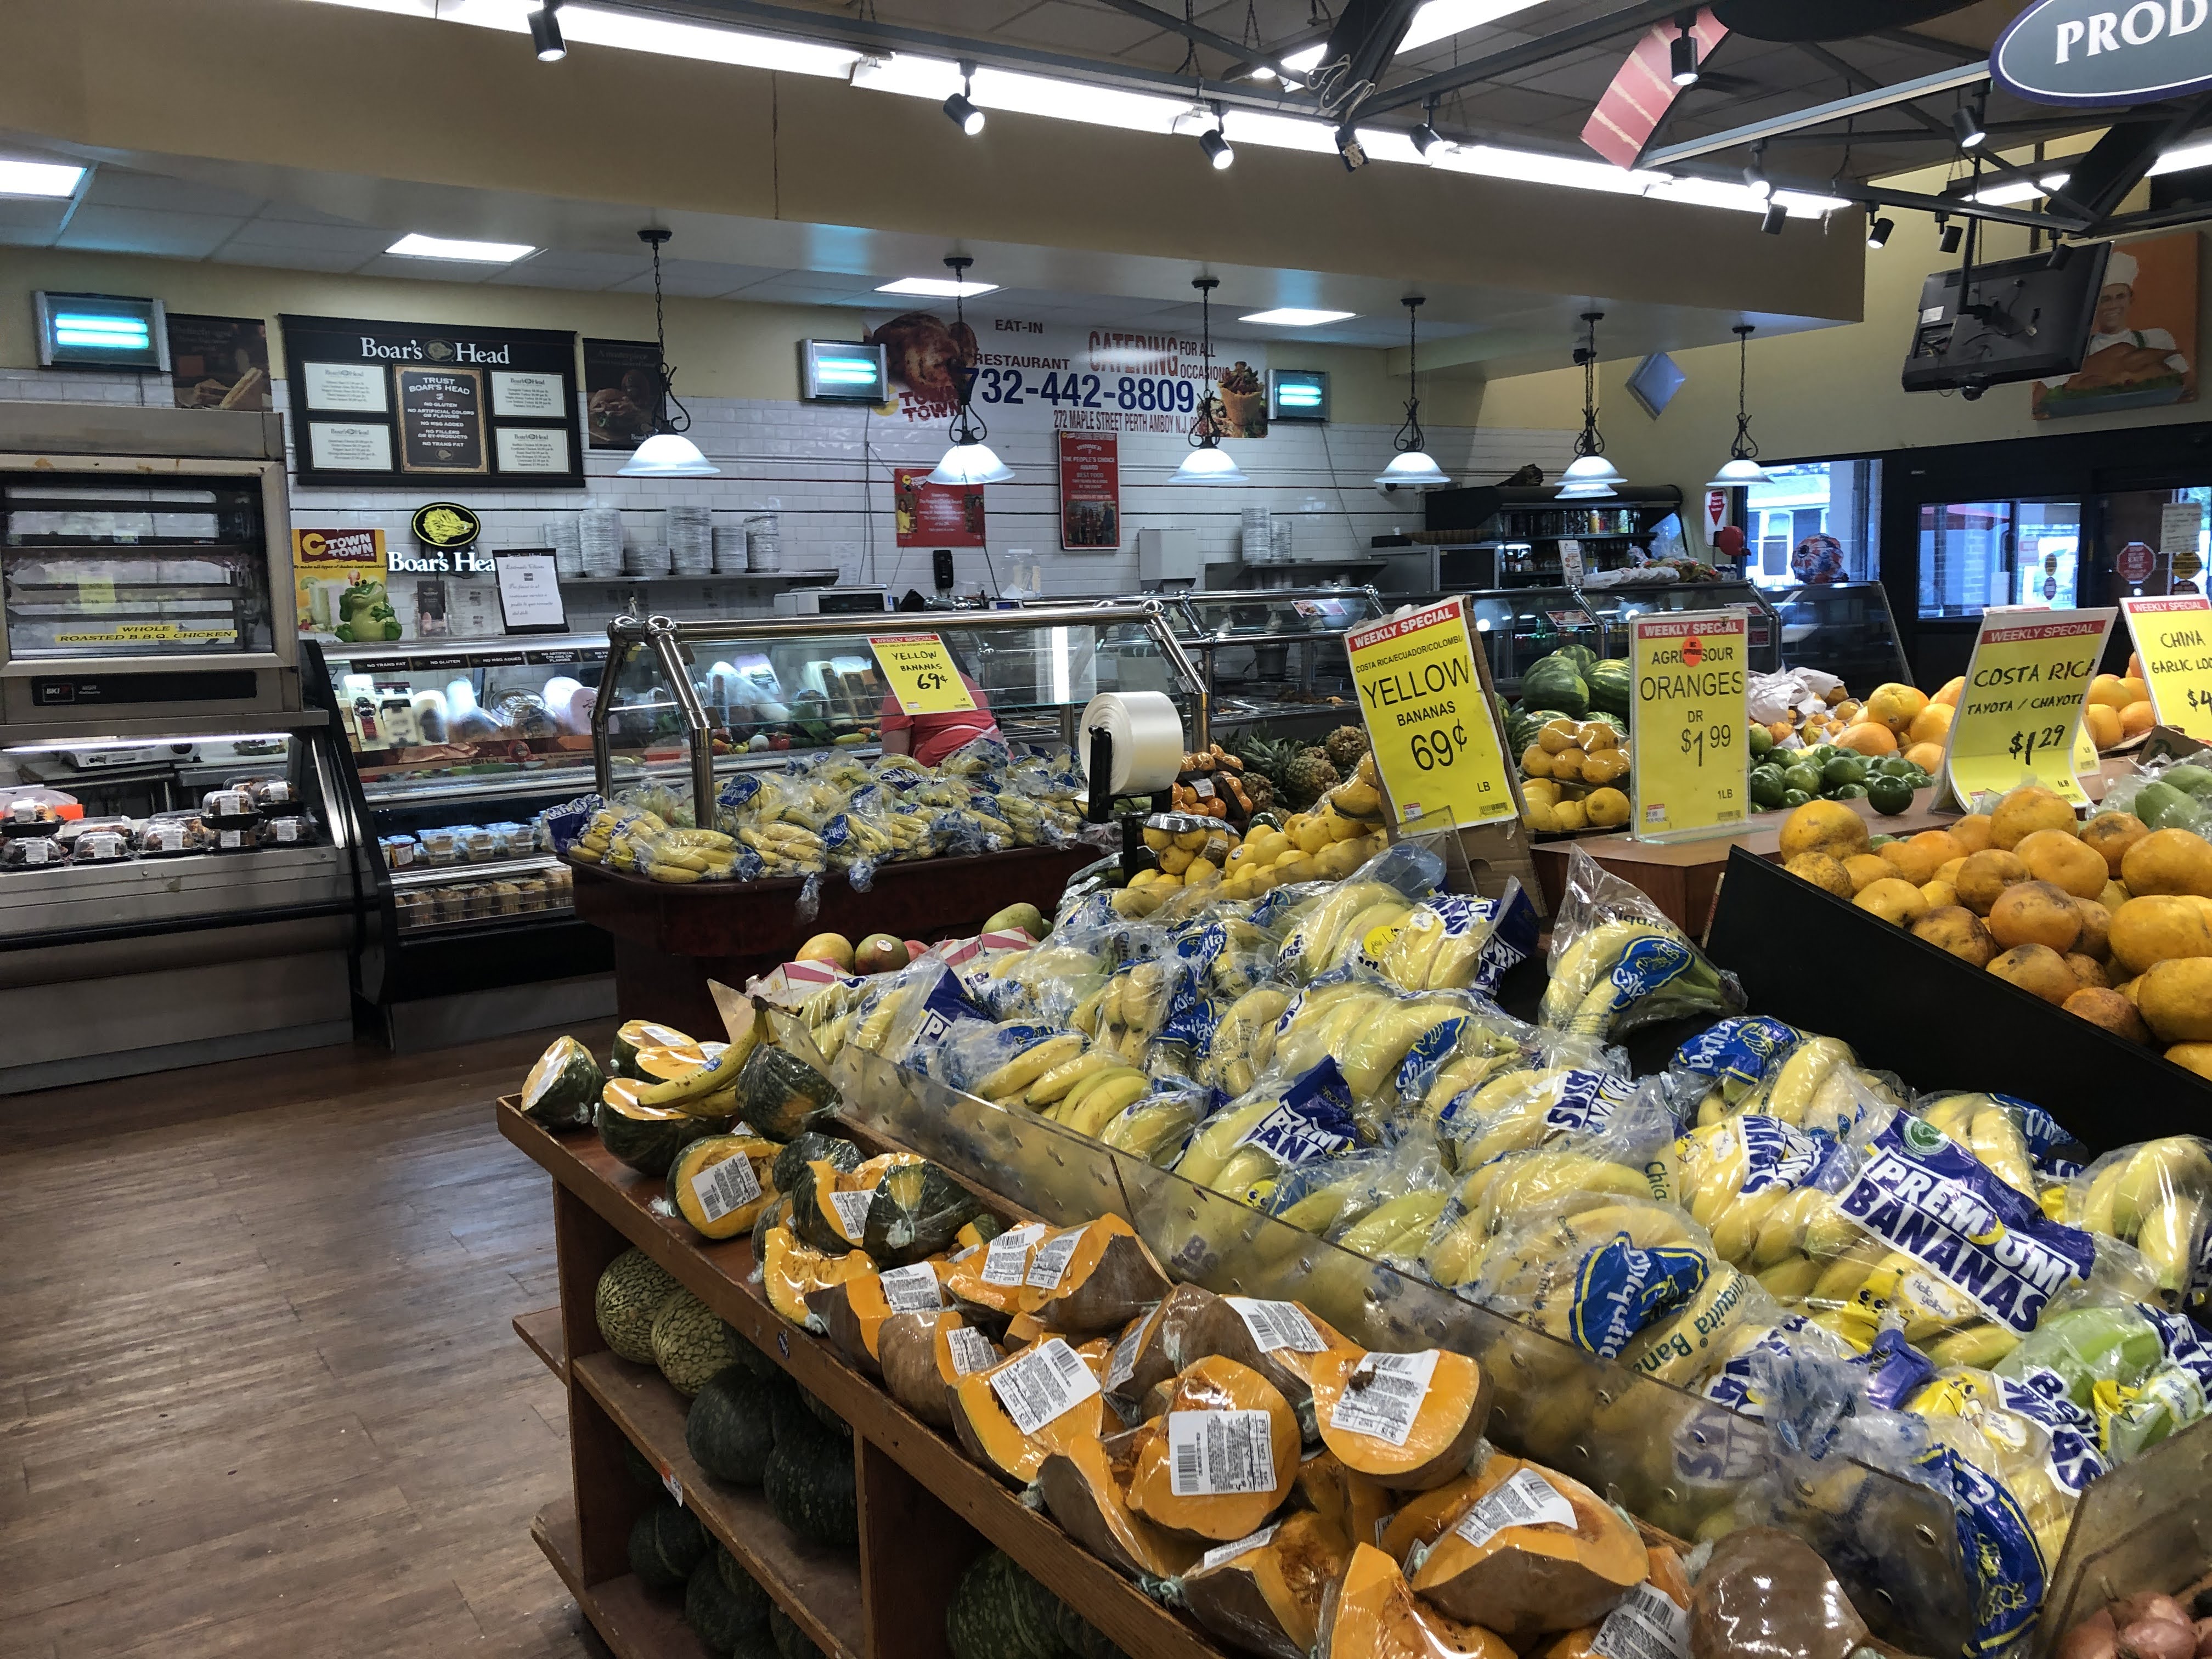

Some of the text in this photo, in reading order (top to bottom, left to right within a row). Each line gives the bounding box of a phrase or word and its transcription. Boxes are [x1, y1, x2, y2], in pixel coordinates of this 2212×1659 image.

[995, 319, 1043, 334] EAT-IN
[360, 337, 510, 364] Boar's Head
[1089, 331, 1178, 377] CATERING
[1180, 341, 1216, 358] FOR ALL
[973, 353, 1070, 370] RESTAURANT
[409, 384, 470, 395] BOAR'S HEAD
[960, 368, 1194, 413] 732-442-8809
[1053, 410, 1068, 428] 272
[1069, 410, 1094, 430] MAPLE
[1096, 411, 1123, 431] STREET
[1124, 413, 1148, 431] PERTH
[1149, 414, 1174, 432] AMBOY
[387, 551, 495, 572] Boar's Hea
[2133, 601, 2204, 613] WEEKLY SPECIAL
[173, 630, 233, 639] CHICKEN
[1354, 608, 1454, 649] WEEKLY SPECIAL
[1644, 620, 1739, 636] WEEKLY SPECIAL
[1990, 623, 2095, 643] WEEKLY SPECIAL
[2159, 630, 2207, 648] CHINA
[891, 651, 936, 661] YELLOW
[900, 663, 943, 672] BANANAS
[1356, 661, 1377, 674] COSTA
[2151, 659, 2192, 674] GARLIC
[1362, 655, 1470, 709] YELLOW
[1974, 664, 2040, 687] COSTA
[1640, 671, 1743, 701] ORANGES
[1396, 701, 1456, 727] BANANAS
[1967, 699, 2013, 715] TAYOTA
[1688, 710, 1703, 723] DR
[1477, 781, 1491, 793] LB
[1871, 1156, 2071, 1301] PREMUM
[1840, 1178, 2050, 1333] BANANAS
